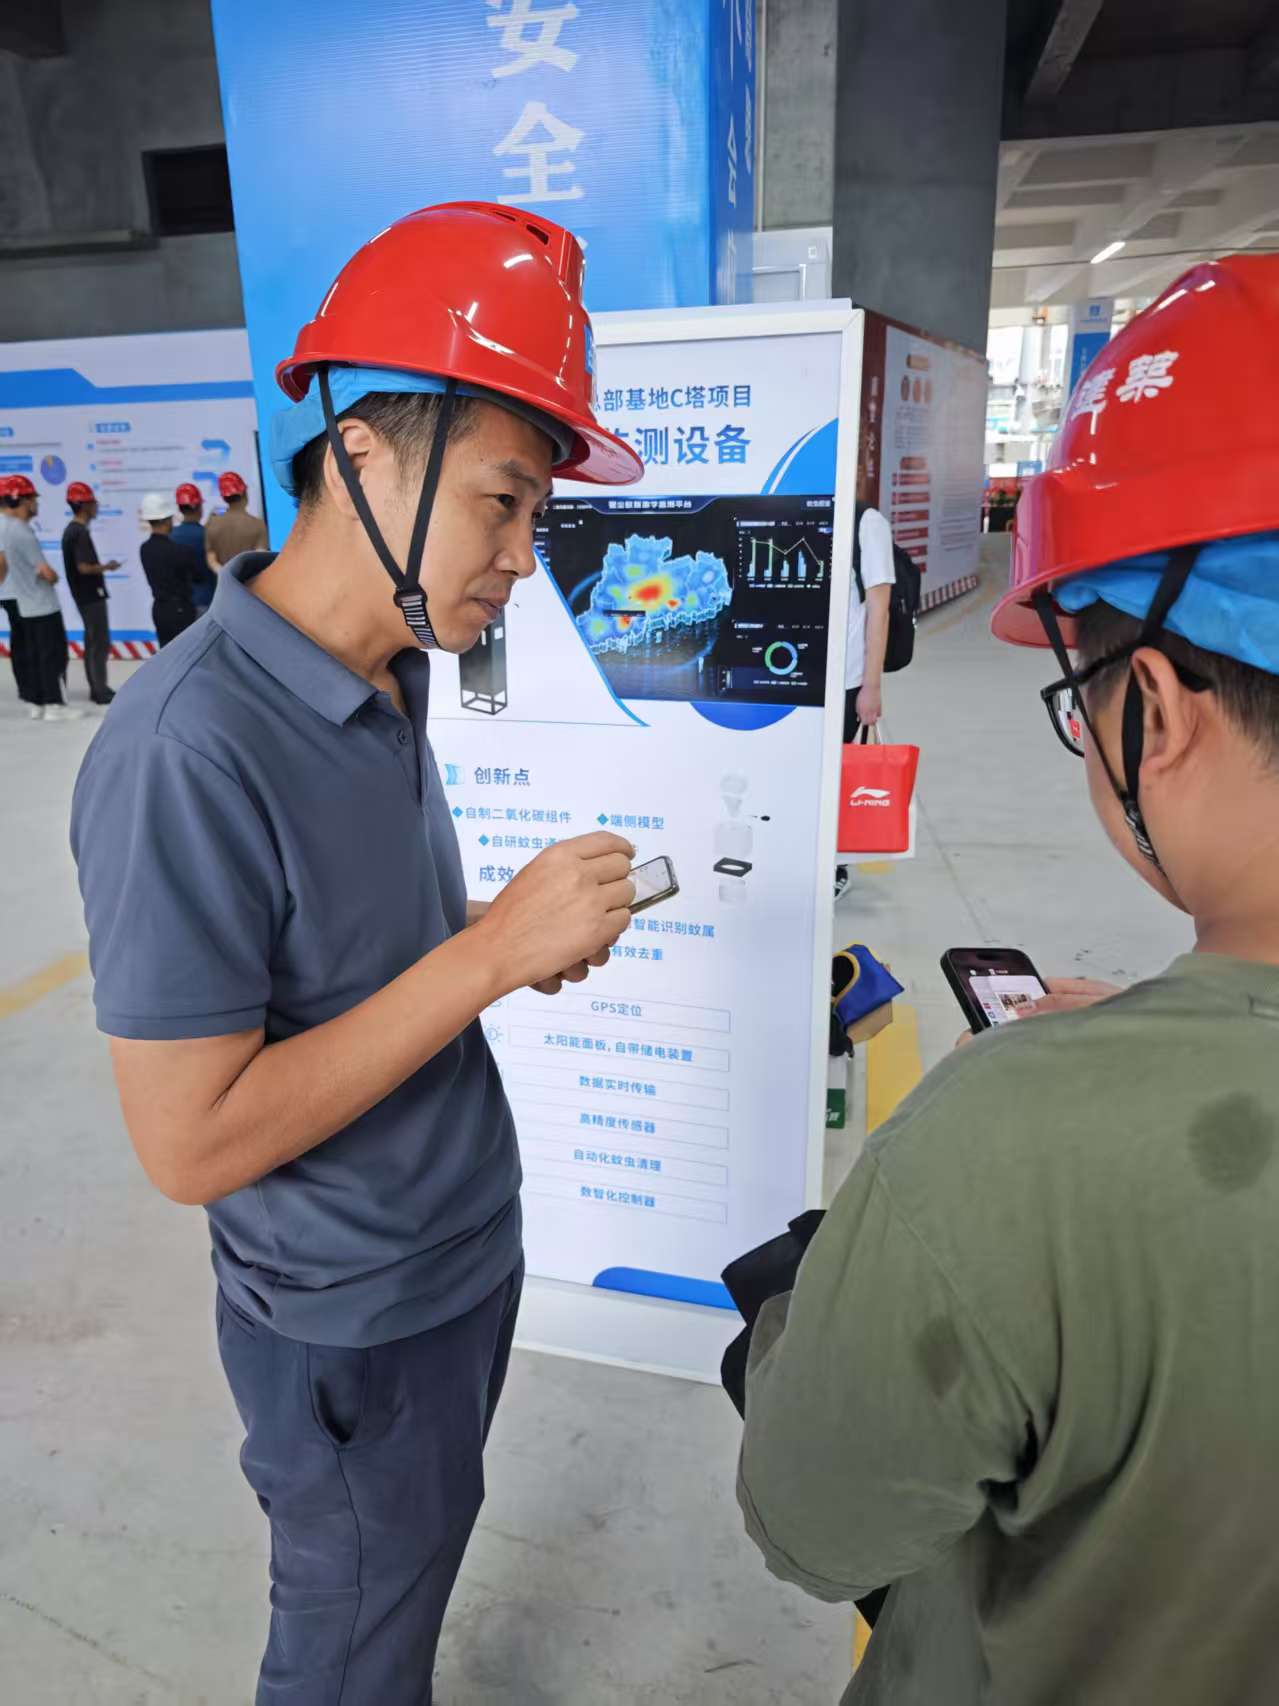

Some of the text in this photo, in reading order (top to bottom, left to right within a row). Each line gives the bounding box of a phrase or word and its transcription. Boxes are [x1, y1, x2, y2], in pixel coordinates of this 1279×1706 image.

[596, 384, 752, 412] 部基地C塔项目
[607, 424, 751, 465] 测设备
[474, 767, 531, 786] 创新点
[465, 806, 572, 824] 自制二氧化碳组件
[610, 814, 665, 831] 端侧模型
[479, 864, 514, 882] 成效
[591, 1000, 642, 1017] GPS定位
[579, 1076, 657, 1096] 数据实时传输
[580, 1113, 656, 1134] 高精度传感器
